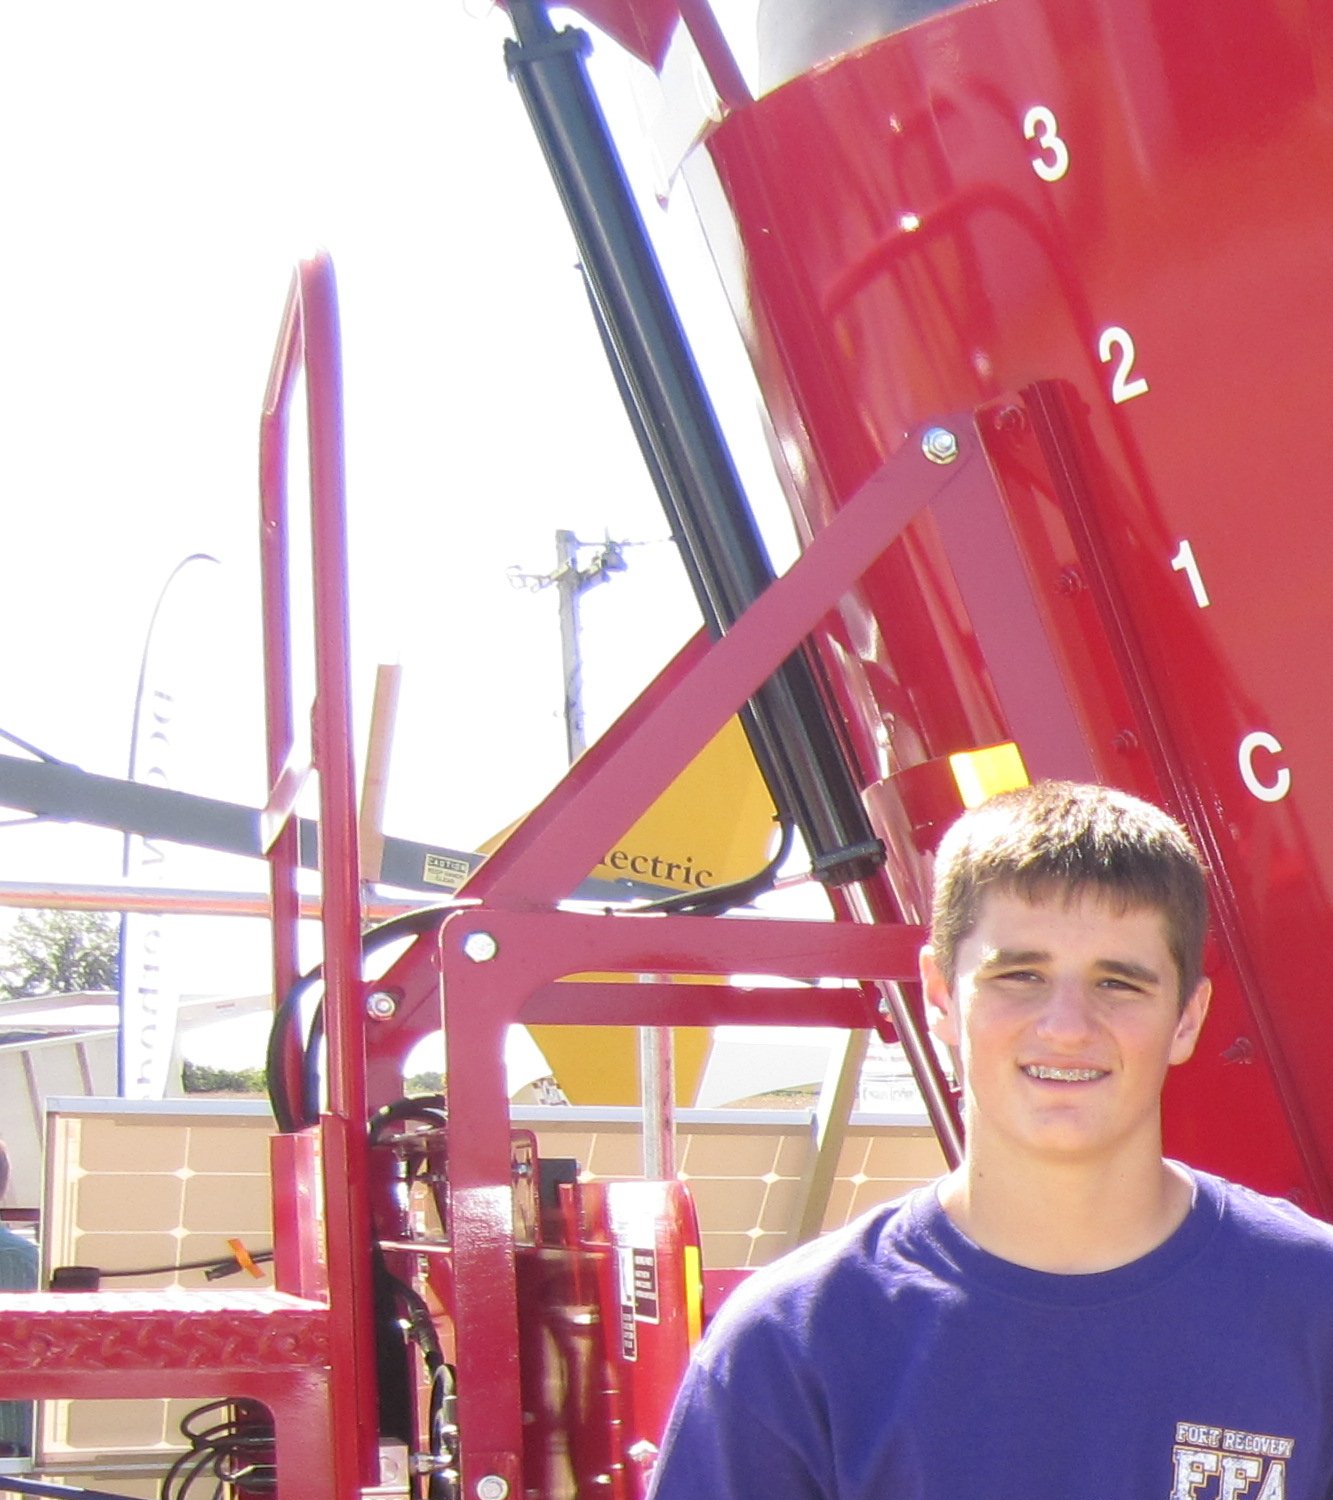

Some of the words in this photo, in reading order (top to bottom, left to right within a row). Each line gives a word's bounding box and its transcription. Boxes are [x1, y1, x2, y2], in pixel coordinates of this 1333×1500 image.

[1023, 106, 1069, 182] 3
[1099, 326, 1149, 404] 2
[1171, 540, 1210, 608] 1
[1238, 732, 1291, 803] C
[1176, 1422, 1222, 1447] FORT
[1223, 1429, 1295, 1459] RECOVERY
